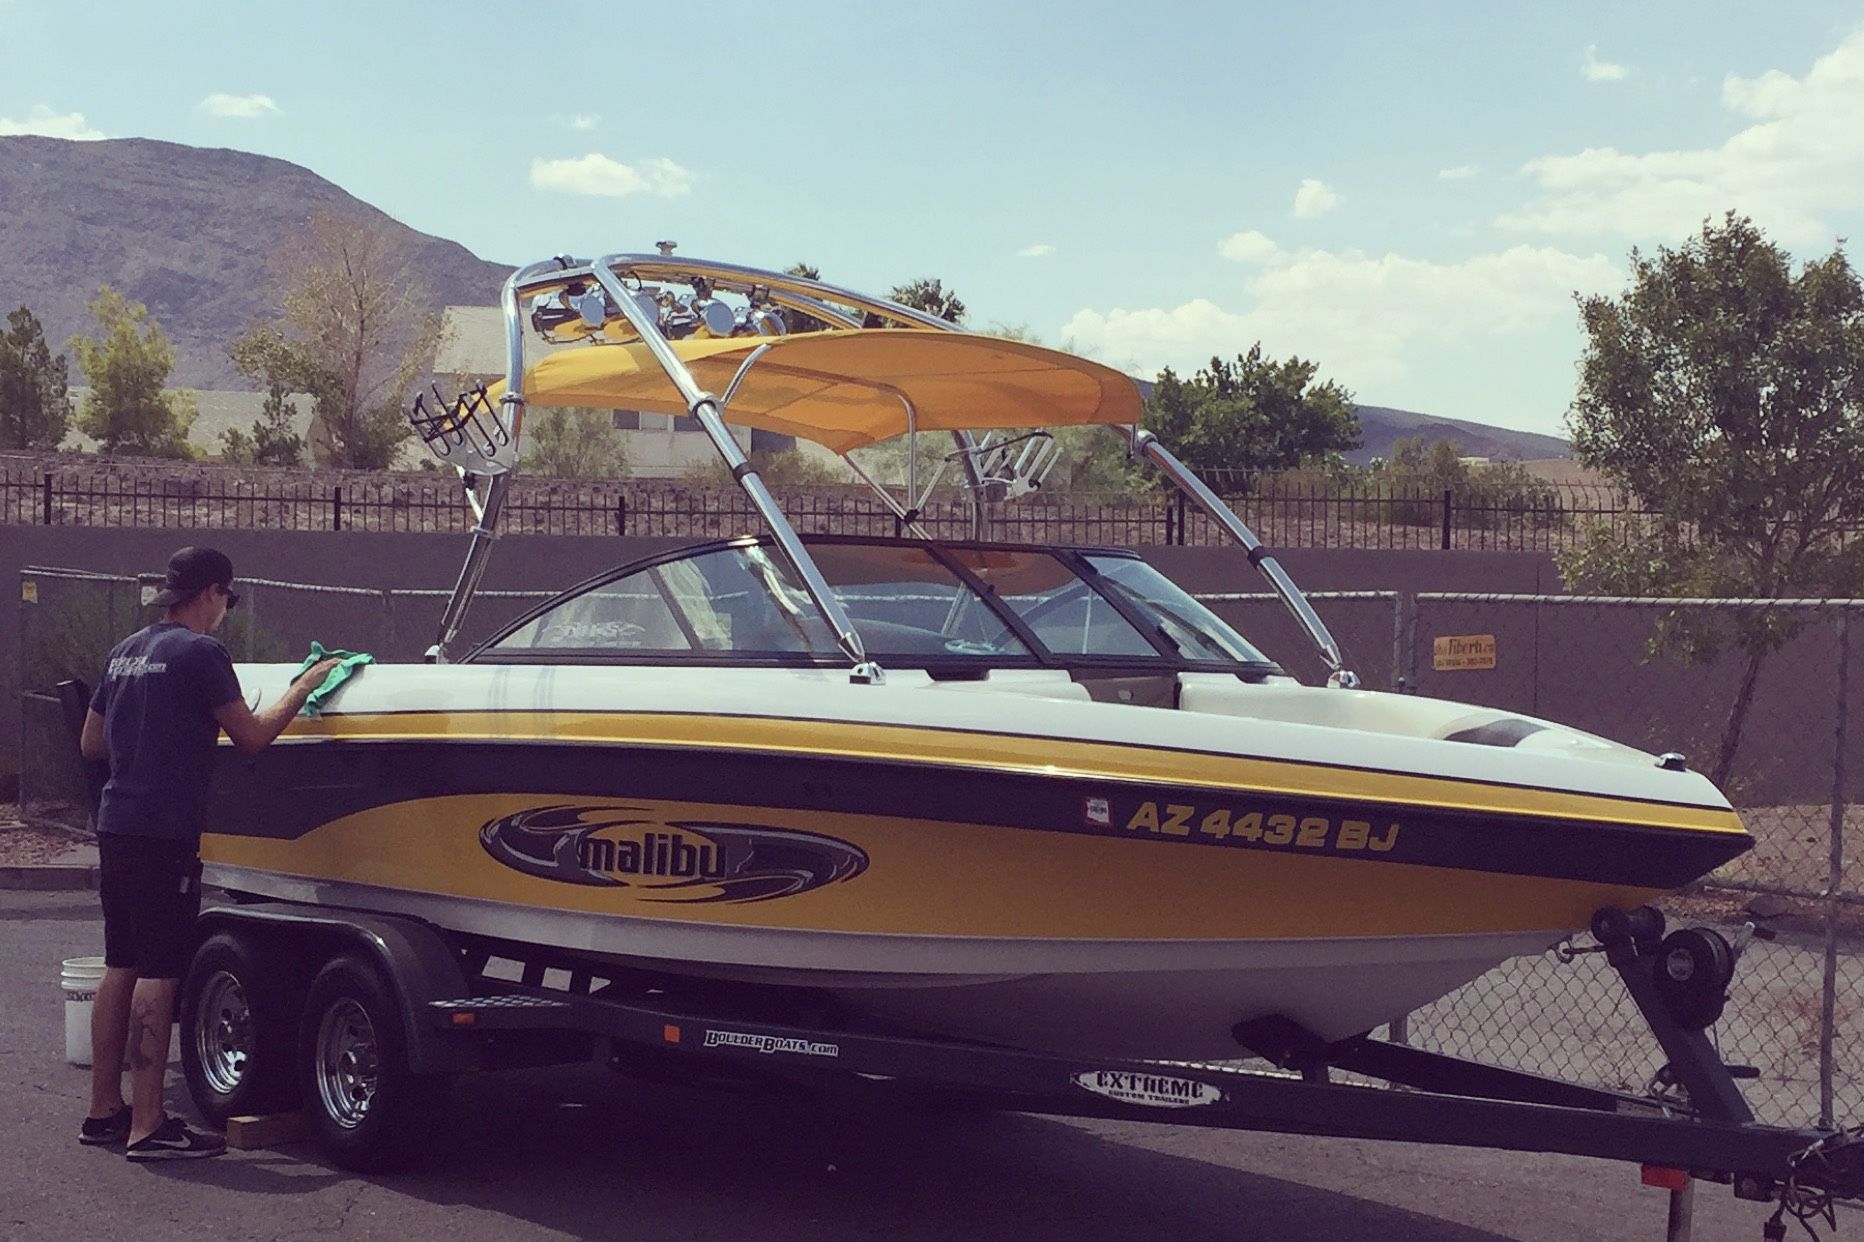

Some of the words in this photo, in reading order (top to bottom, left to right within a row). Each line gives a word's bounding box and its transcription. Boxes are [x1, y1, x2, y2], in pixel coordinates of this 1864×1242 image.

[1127, 802, 1195, 836] AZ
[1200, 809, 1329, 847] 4432
[1336, 820, 1399, 850] BJ
[581, 832, 726, 879] malibu
